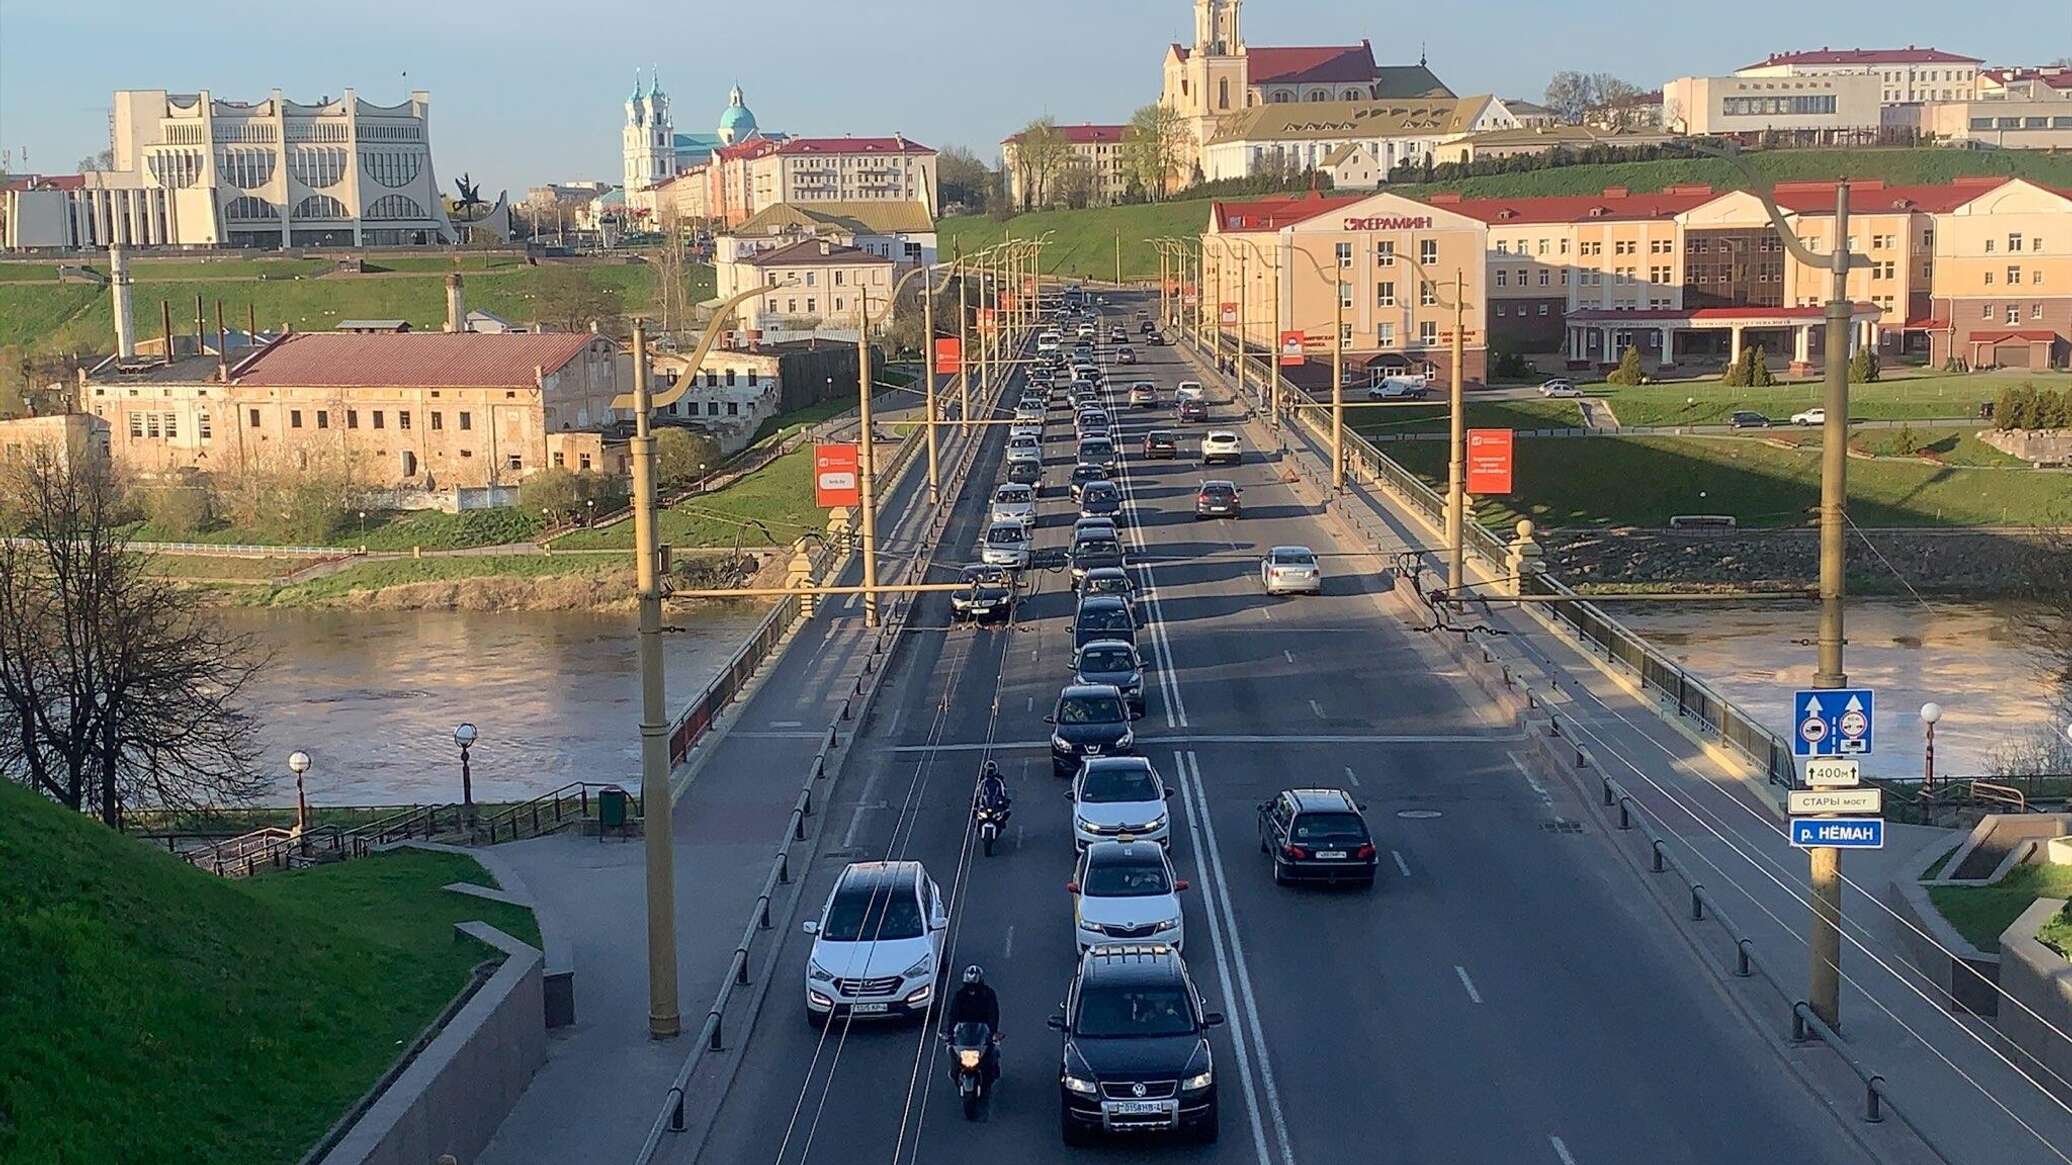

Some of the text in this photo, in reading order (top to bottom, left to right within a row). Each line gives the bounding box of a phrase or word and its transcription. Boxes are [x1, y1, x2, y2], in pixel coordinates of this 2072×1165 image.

[1359, 216, 1433, 231] КЕРАМИН
[1817, 767, 1849, 778] 400м
[1802, 797, 1840, 807] СТАРЫ
[1801, 825, 1874, 842] р. НЁМАН
